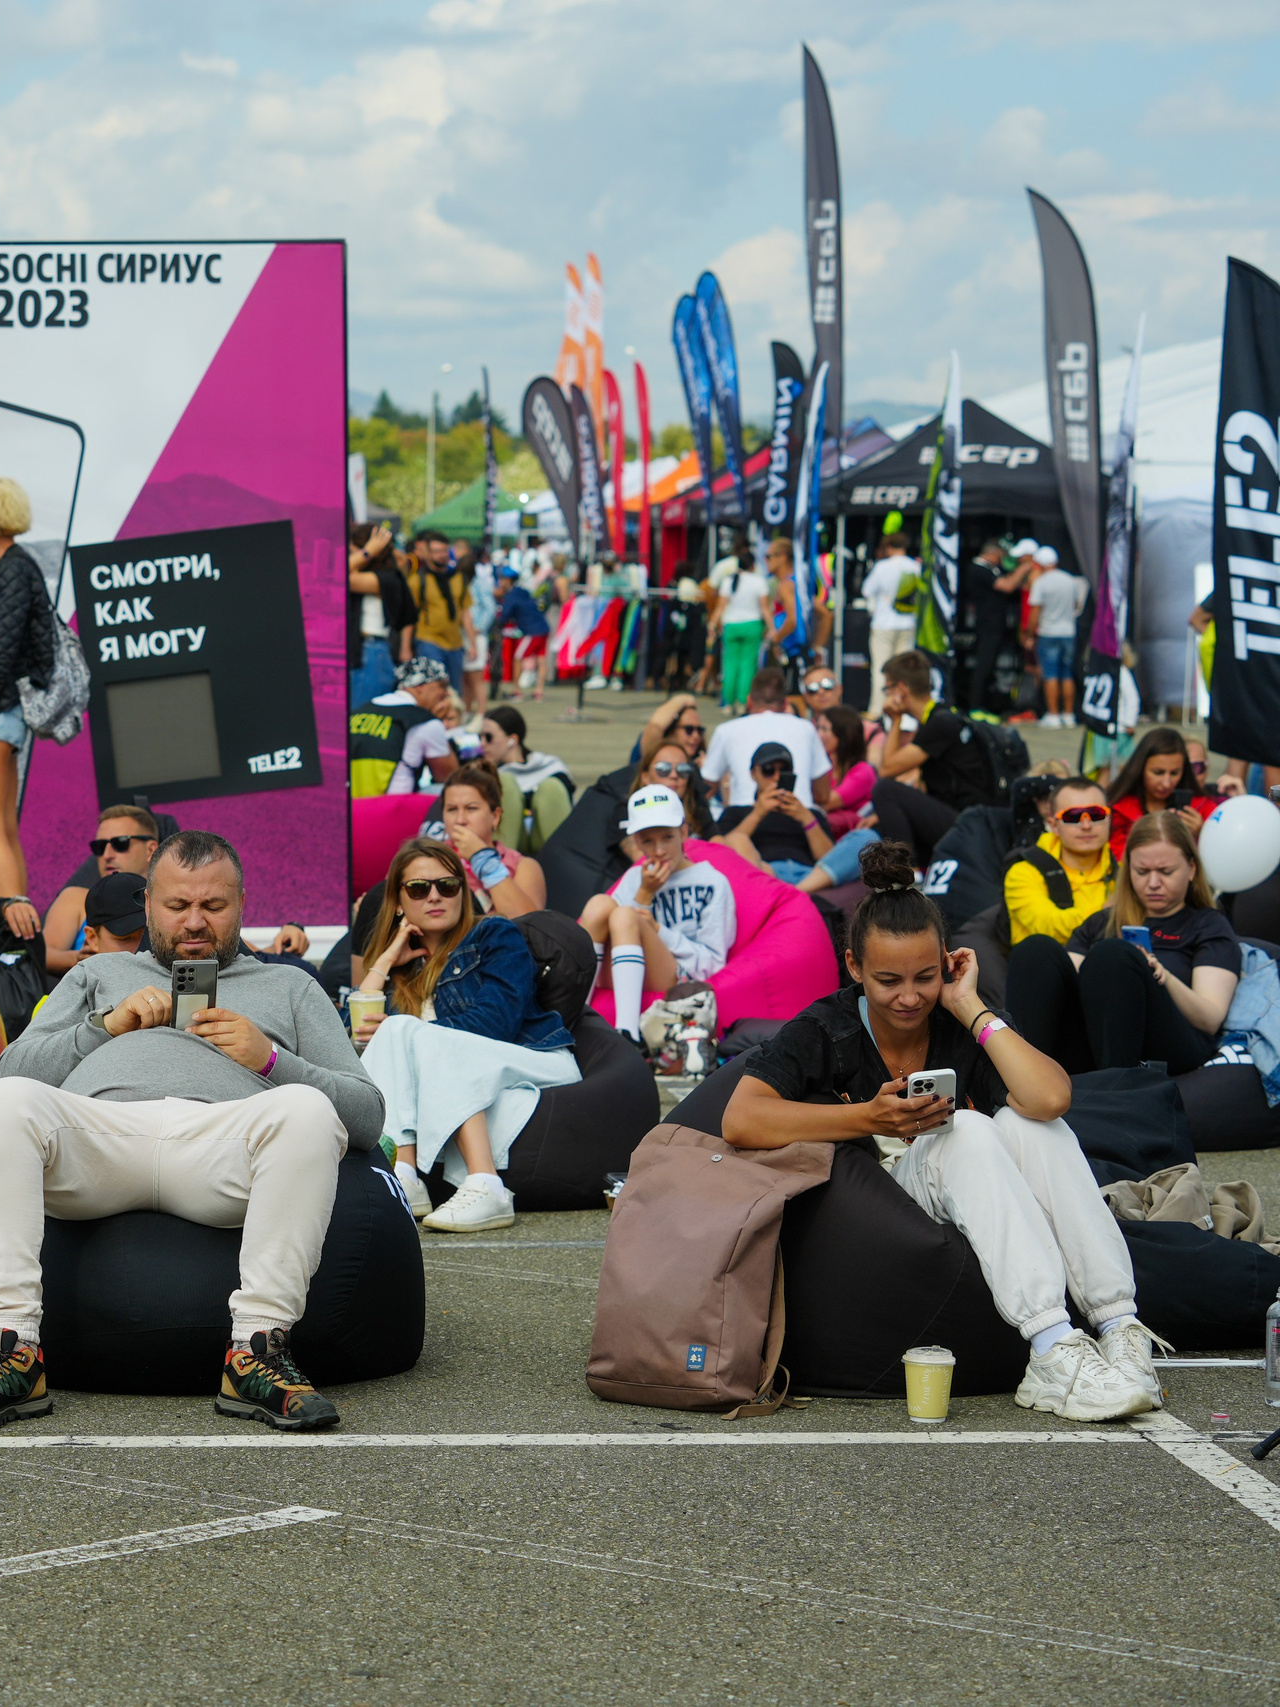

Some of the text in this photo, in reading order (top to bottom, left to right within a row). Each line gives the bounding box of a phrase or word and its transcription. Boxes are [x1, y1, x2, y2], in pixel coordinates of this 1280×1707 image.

[97, 253, 222, 284] СИРИУС
[89, 553, 221, 590] СМОТРИ,
[94, 596, 155, 627] КАК
[98, 625, 206, 663] Я МОГУ
[248, 746, 302, 774] TELE2
